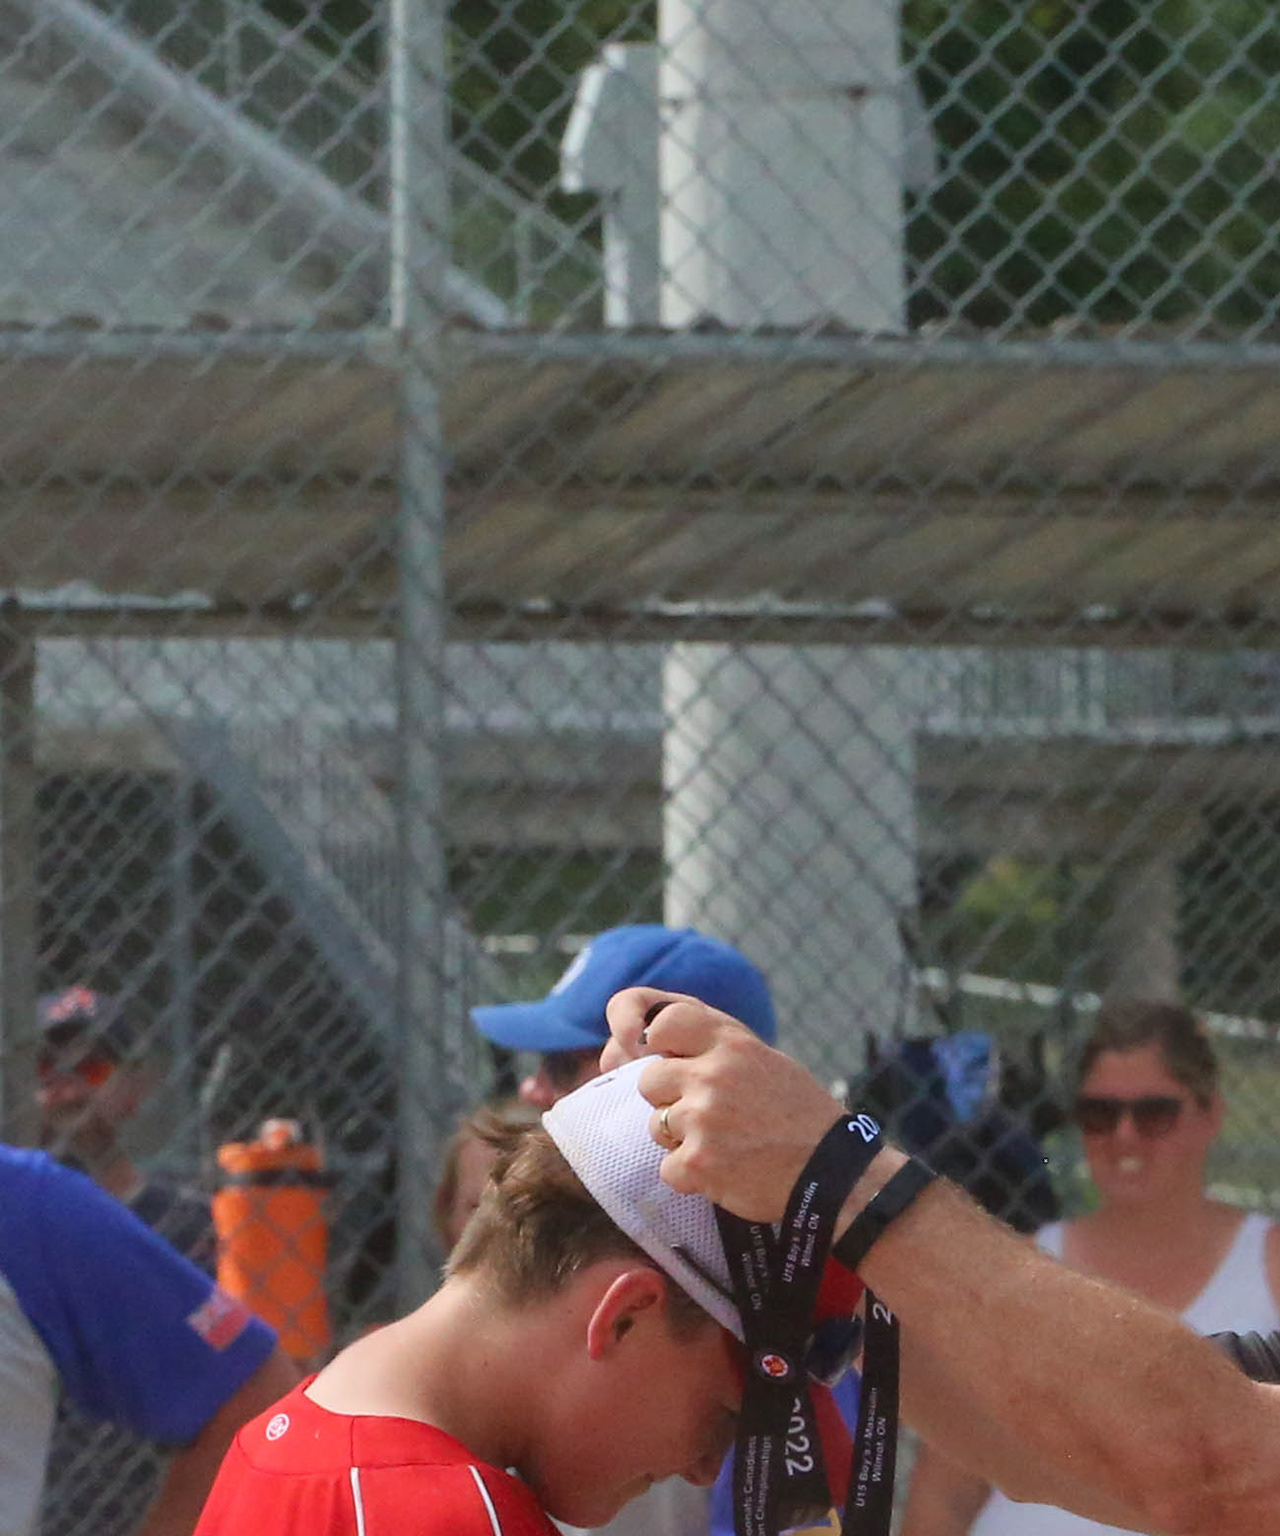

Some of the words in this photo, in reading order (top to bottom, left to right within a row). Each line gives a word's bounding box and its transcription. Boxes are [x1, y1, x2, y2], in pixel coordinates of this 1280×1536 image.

[781, 1262, 795, 1283] U15
[792, 1181, 819, 1229] Masculin
[807, 1212, 821, 1230] ON
[855, 1484, 868, 1507] U15
[863, 1387, 878, 1439] Masculin
[876, 1417, 887, 1436] ON
